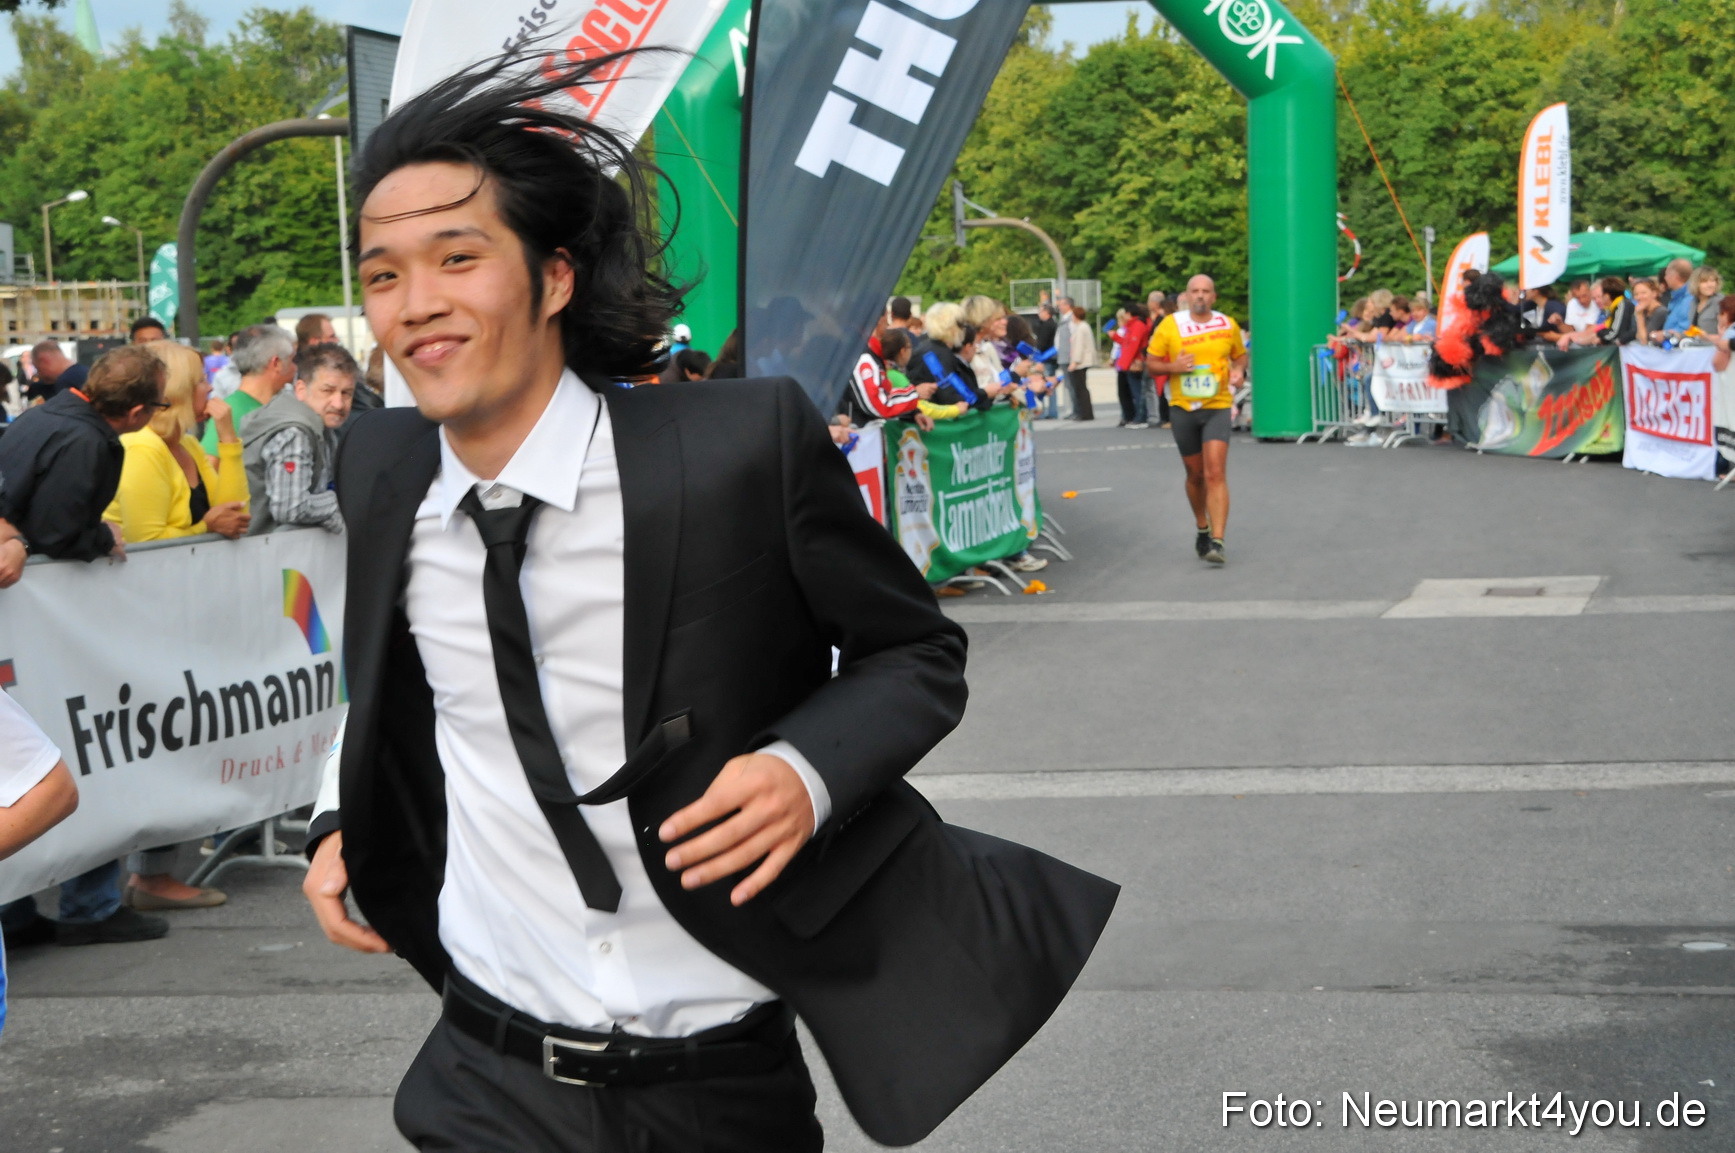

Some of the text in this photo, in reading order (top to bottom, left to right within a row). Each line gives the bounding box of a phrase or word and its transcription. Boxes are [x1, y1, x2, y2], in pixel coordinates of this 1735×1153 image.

[540, 0, 657, 108] Fact
[1203, 0, 1304, 80] OK
[794, 0, 979, 187] TH
[1534, 125, 1554, 228] KLEBL
[1183, 376, 1211, 388] 414
[1632, 372, 1707, 441] MEIER
[65, 660, 334, 777] Frischmann
[220, 745, 286, 785] Druck
